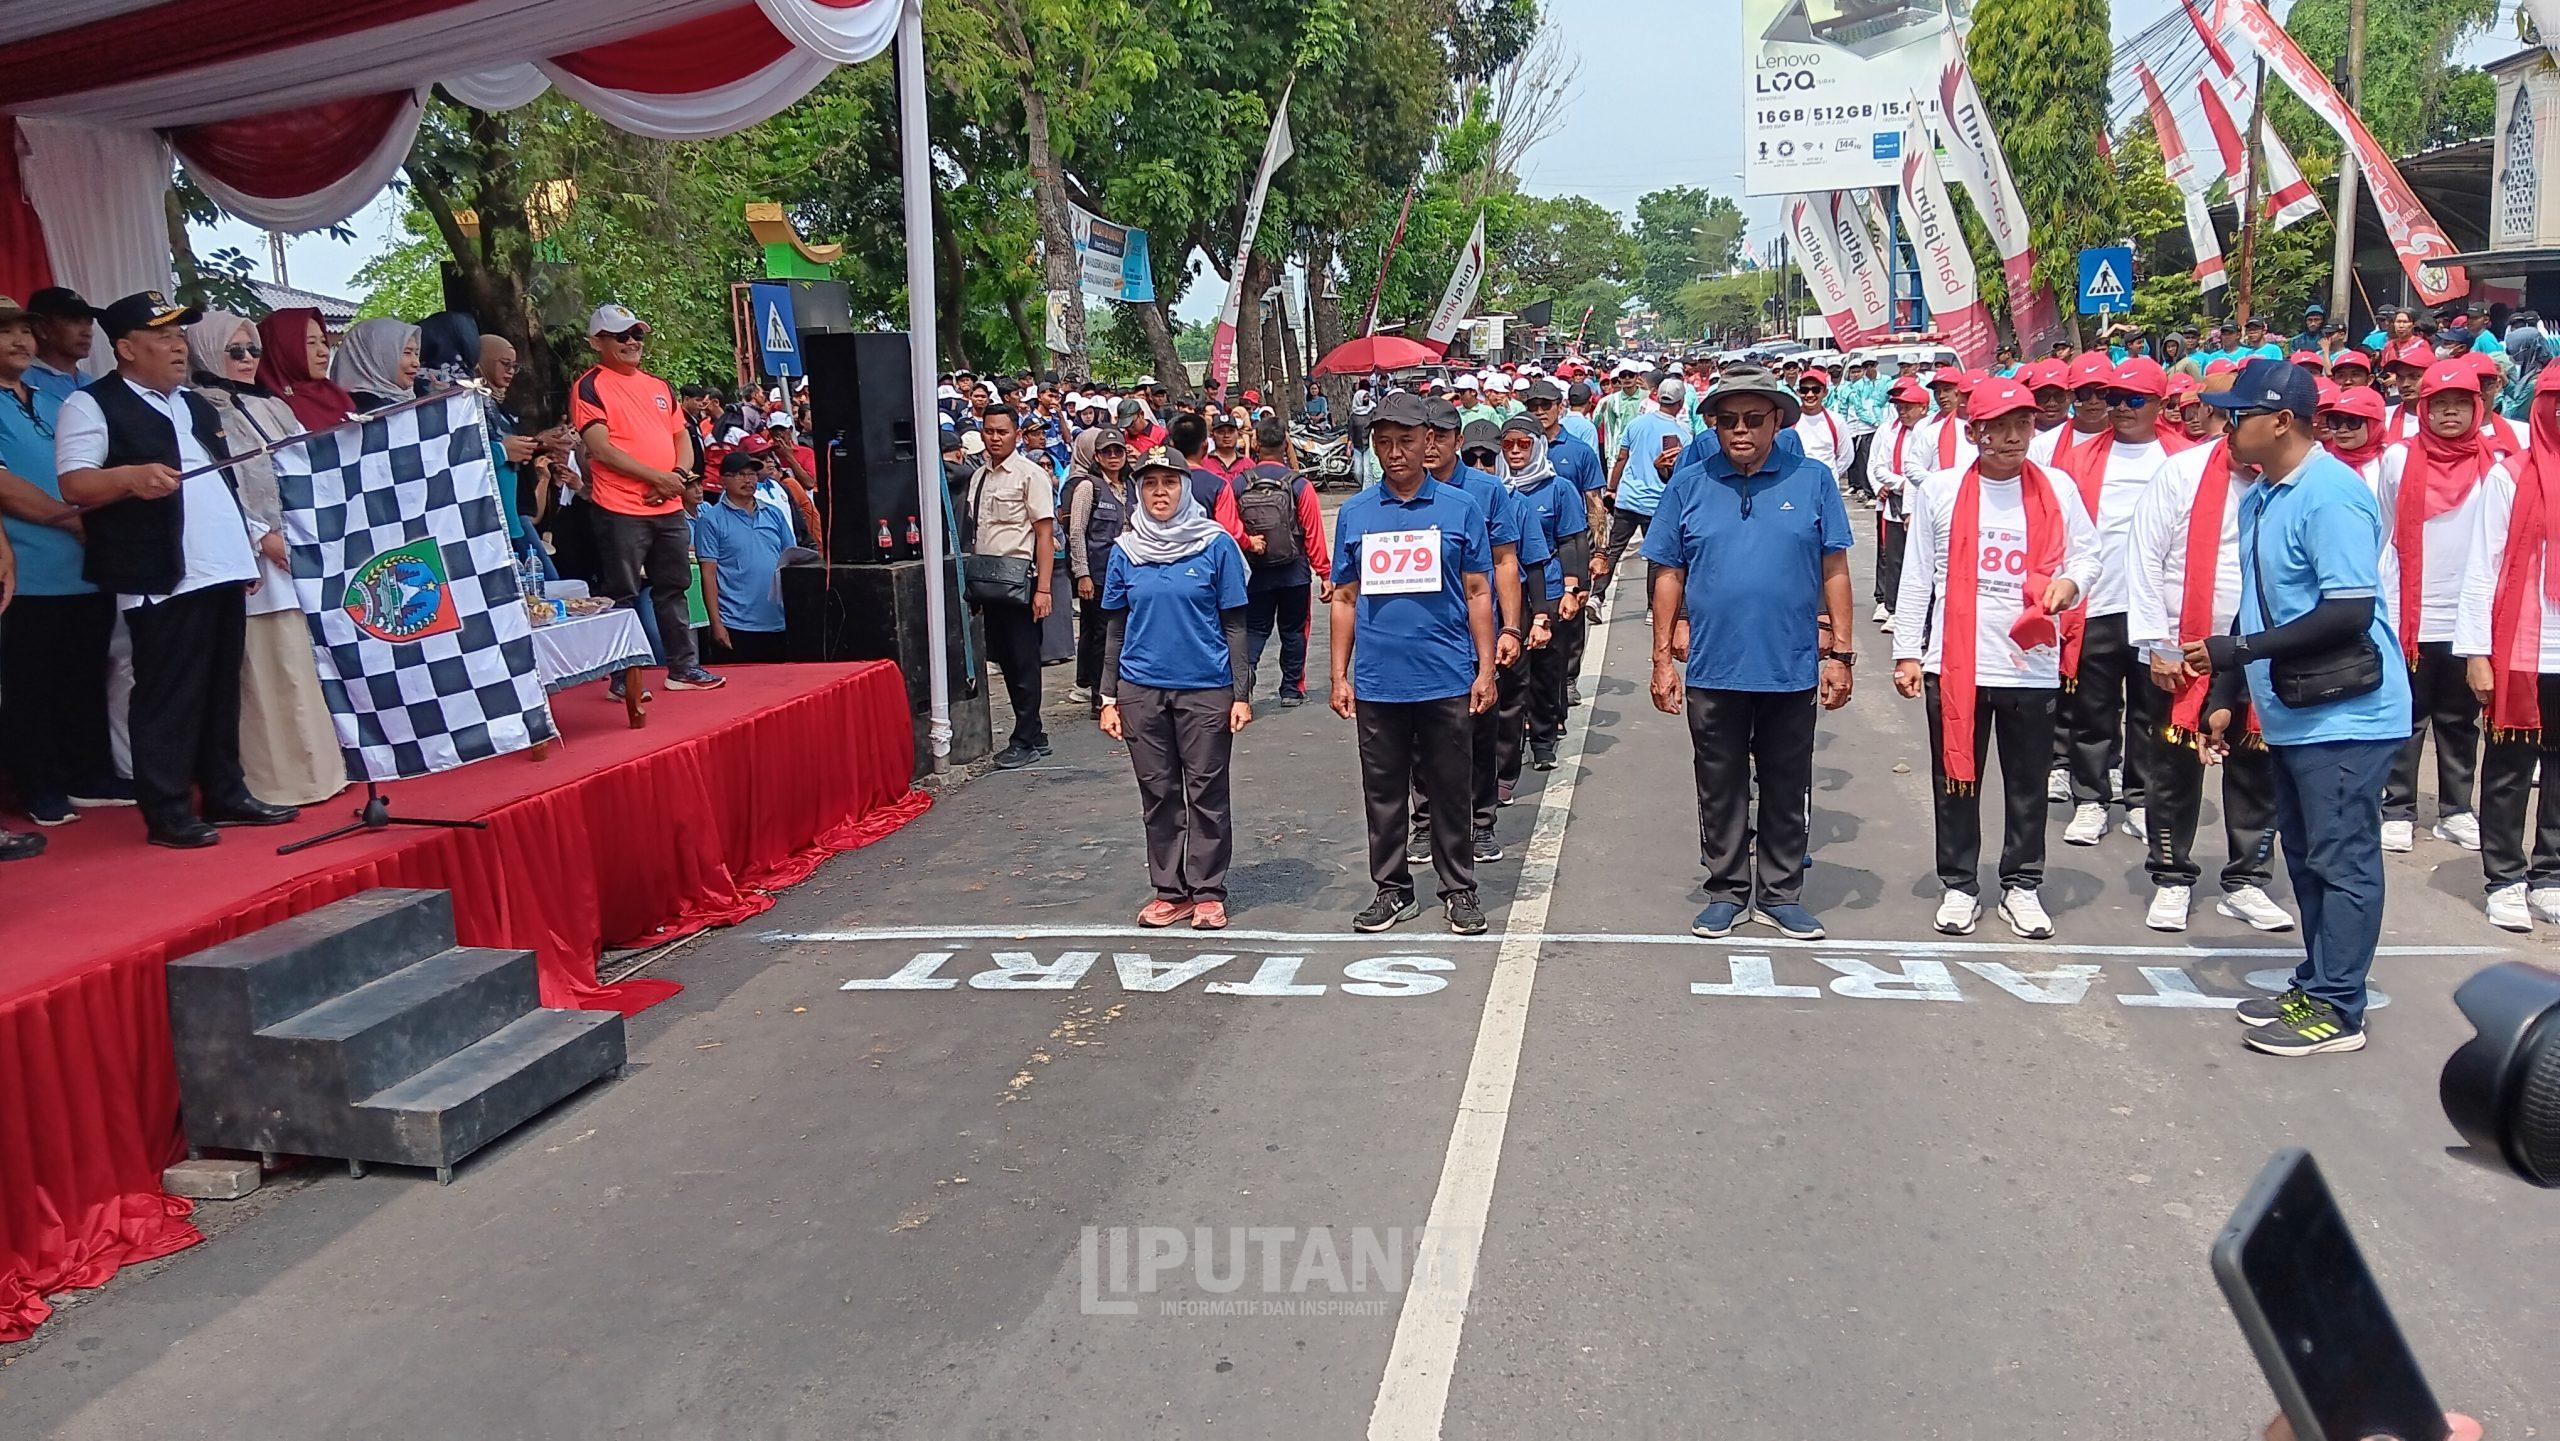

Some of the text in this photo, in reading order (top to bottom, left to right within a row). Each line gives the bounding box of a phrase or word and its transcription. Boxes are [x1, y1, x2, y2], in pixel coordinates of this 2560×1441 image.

[1756, 53, 1821, 69] Lenovo
[1756, 70, 1816, 93] LOQ
[1434, 263, 1474, 332] bankjatim
[1369, 547, 1433, 574] 079
[839, 951, 1457, 996] START
